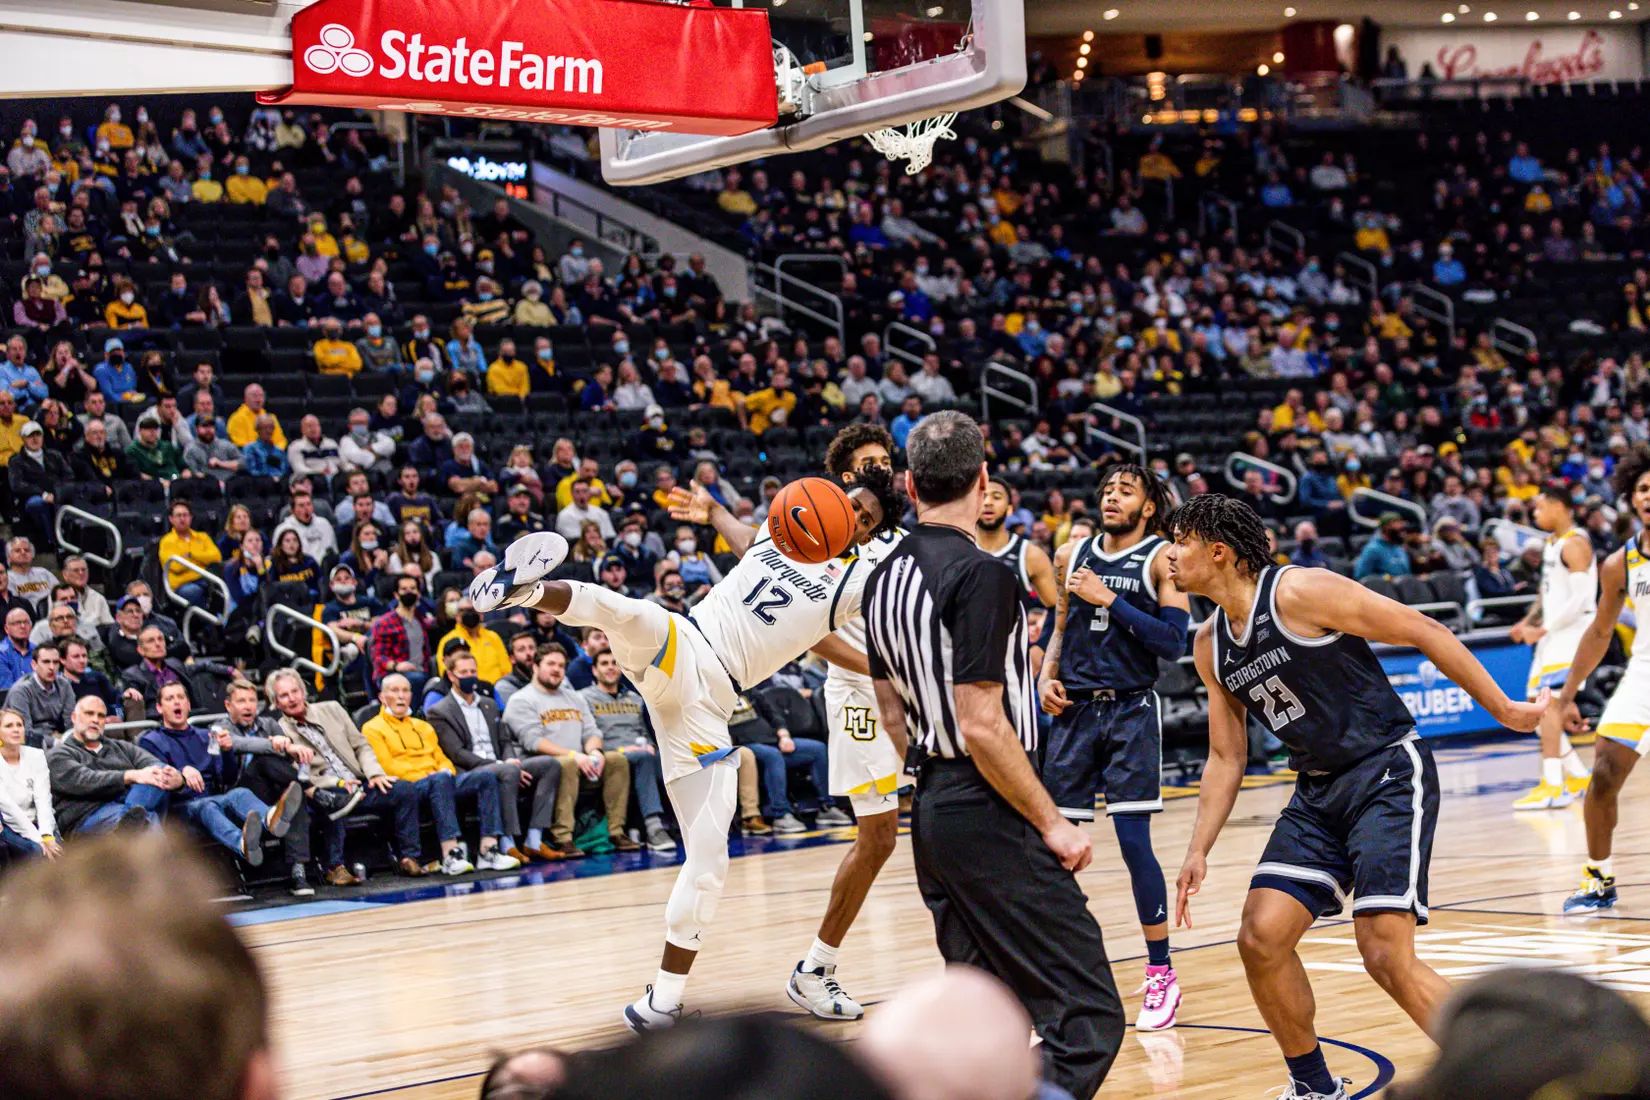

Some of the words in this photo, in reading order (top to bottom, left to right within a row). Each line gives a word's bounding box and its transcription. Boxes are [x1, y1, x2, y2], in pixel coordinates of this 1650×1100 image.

[772, 515, 793, 553] ELITE
[752, 548, 829, 604] Marquette
[742, 575, 794, 626] 12
[1224, 645, 1292, 693] GEORGETOWN
[844, 705, 878, 742] MU
[1248, 674, 1307, 732] 23
[1397, 686, 1475, 717] RUBER
